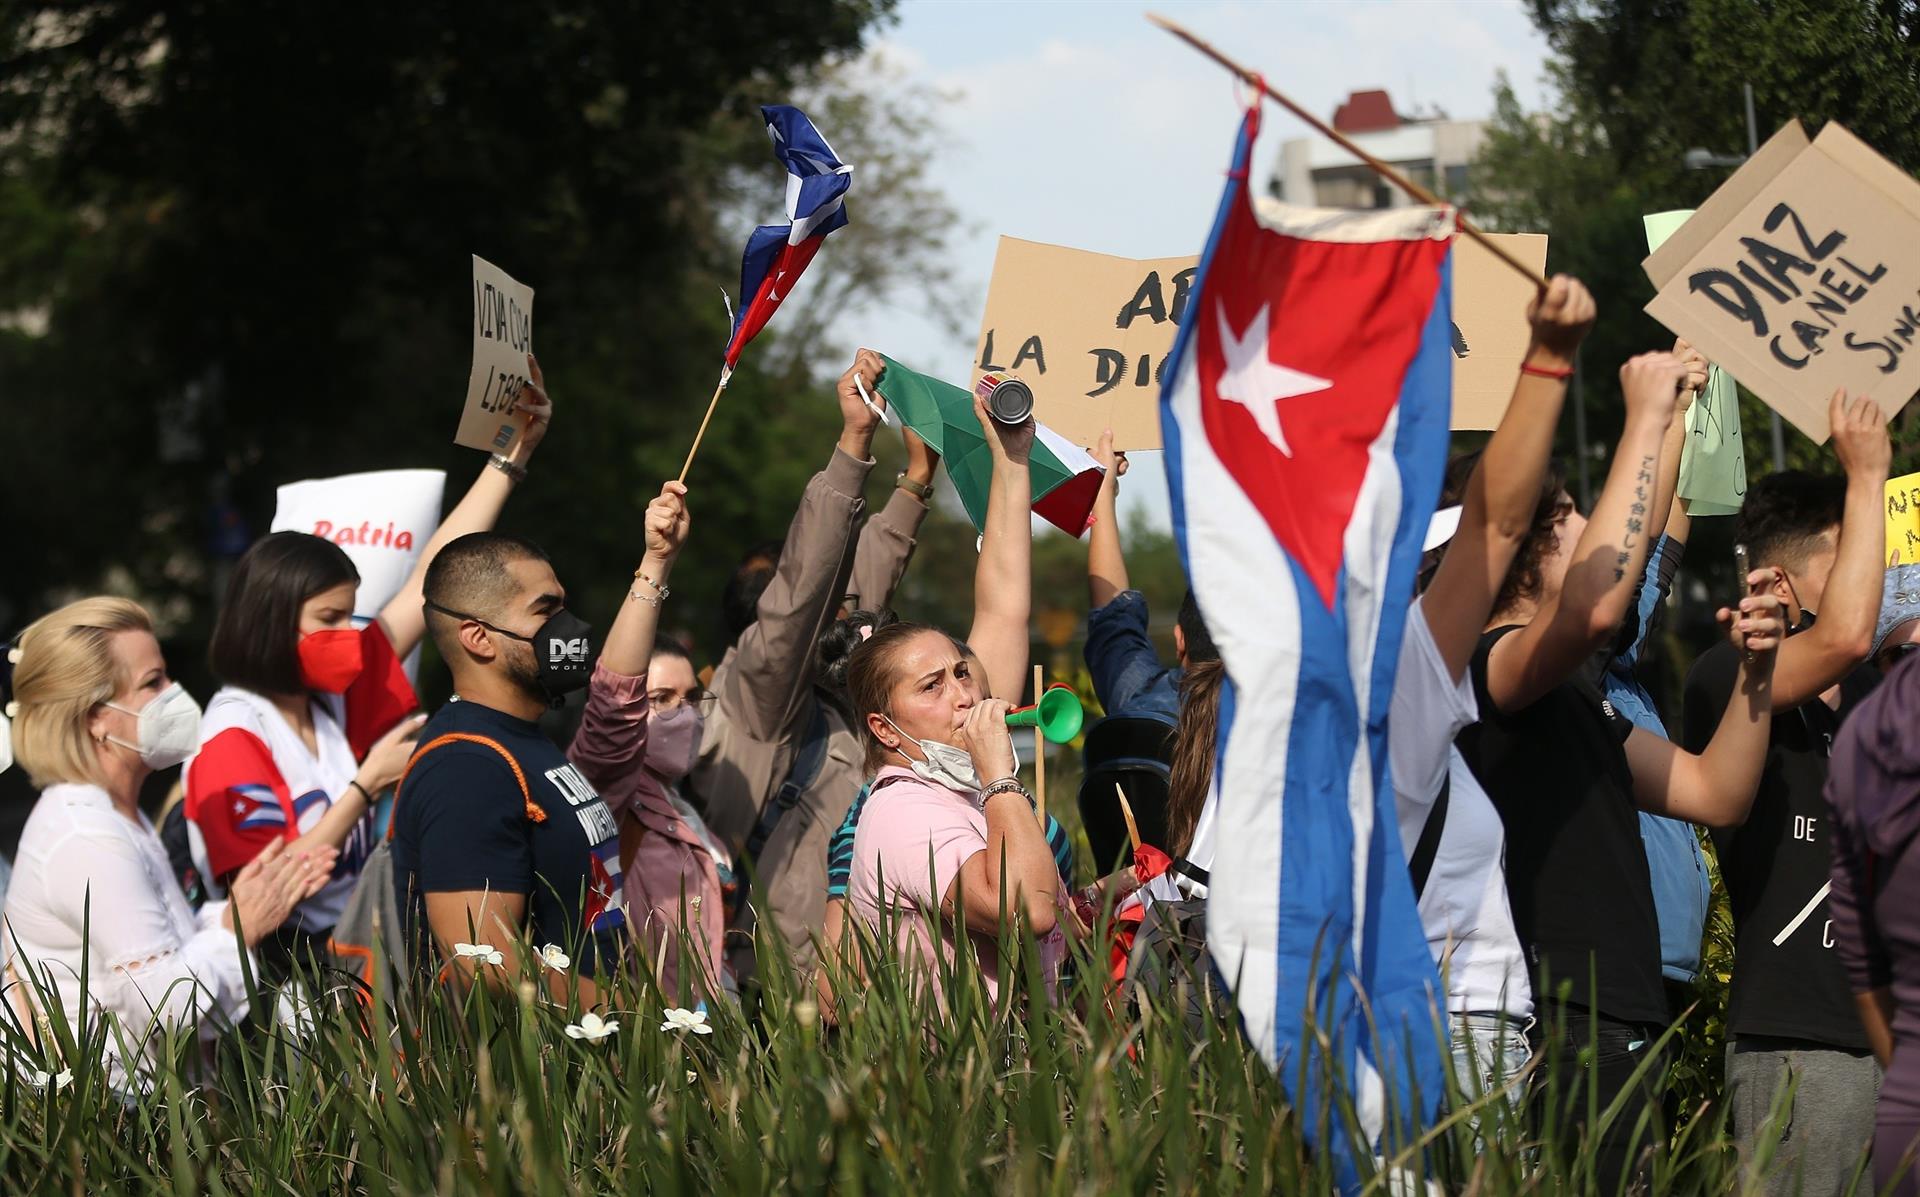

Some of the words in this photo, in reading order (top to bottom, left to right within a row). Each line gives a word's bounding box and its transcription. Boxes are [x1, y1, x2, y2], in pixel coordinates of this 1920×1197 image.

[1689, 202, 1848, 337] DIAZ
[476, 279, 508, 343] VIVA
[1770, 256, 1888, 370] CANEL
[979, 328, 1047, 376] LA
[312, 520, 413, 552] Patria
